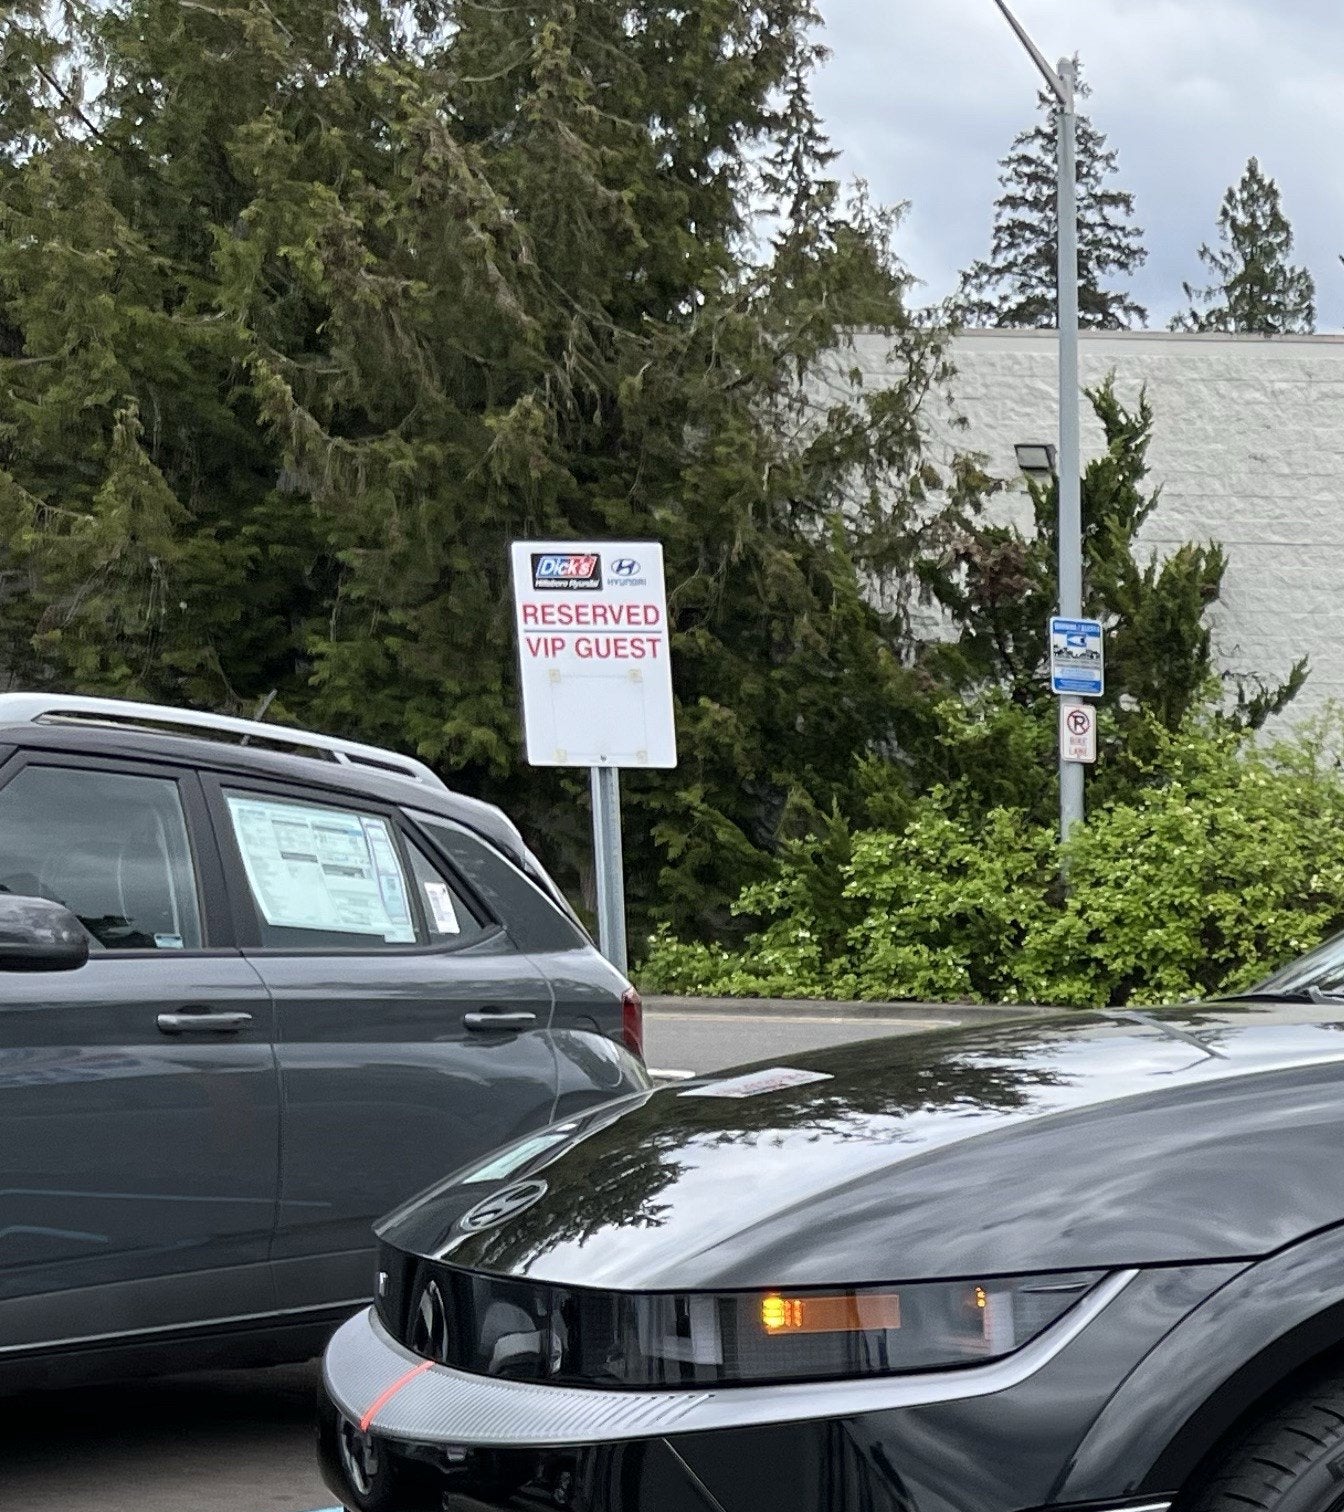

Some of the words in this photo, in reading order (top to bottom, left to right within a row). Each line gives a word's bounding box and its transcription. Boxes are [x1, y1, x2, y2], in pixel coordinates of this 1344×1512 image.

[522, 603, 661, 627] RESERVED
[526, 637, 566, 658] VIP
[574, 637, 662, 660] GUEST
